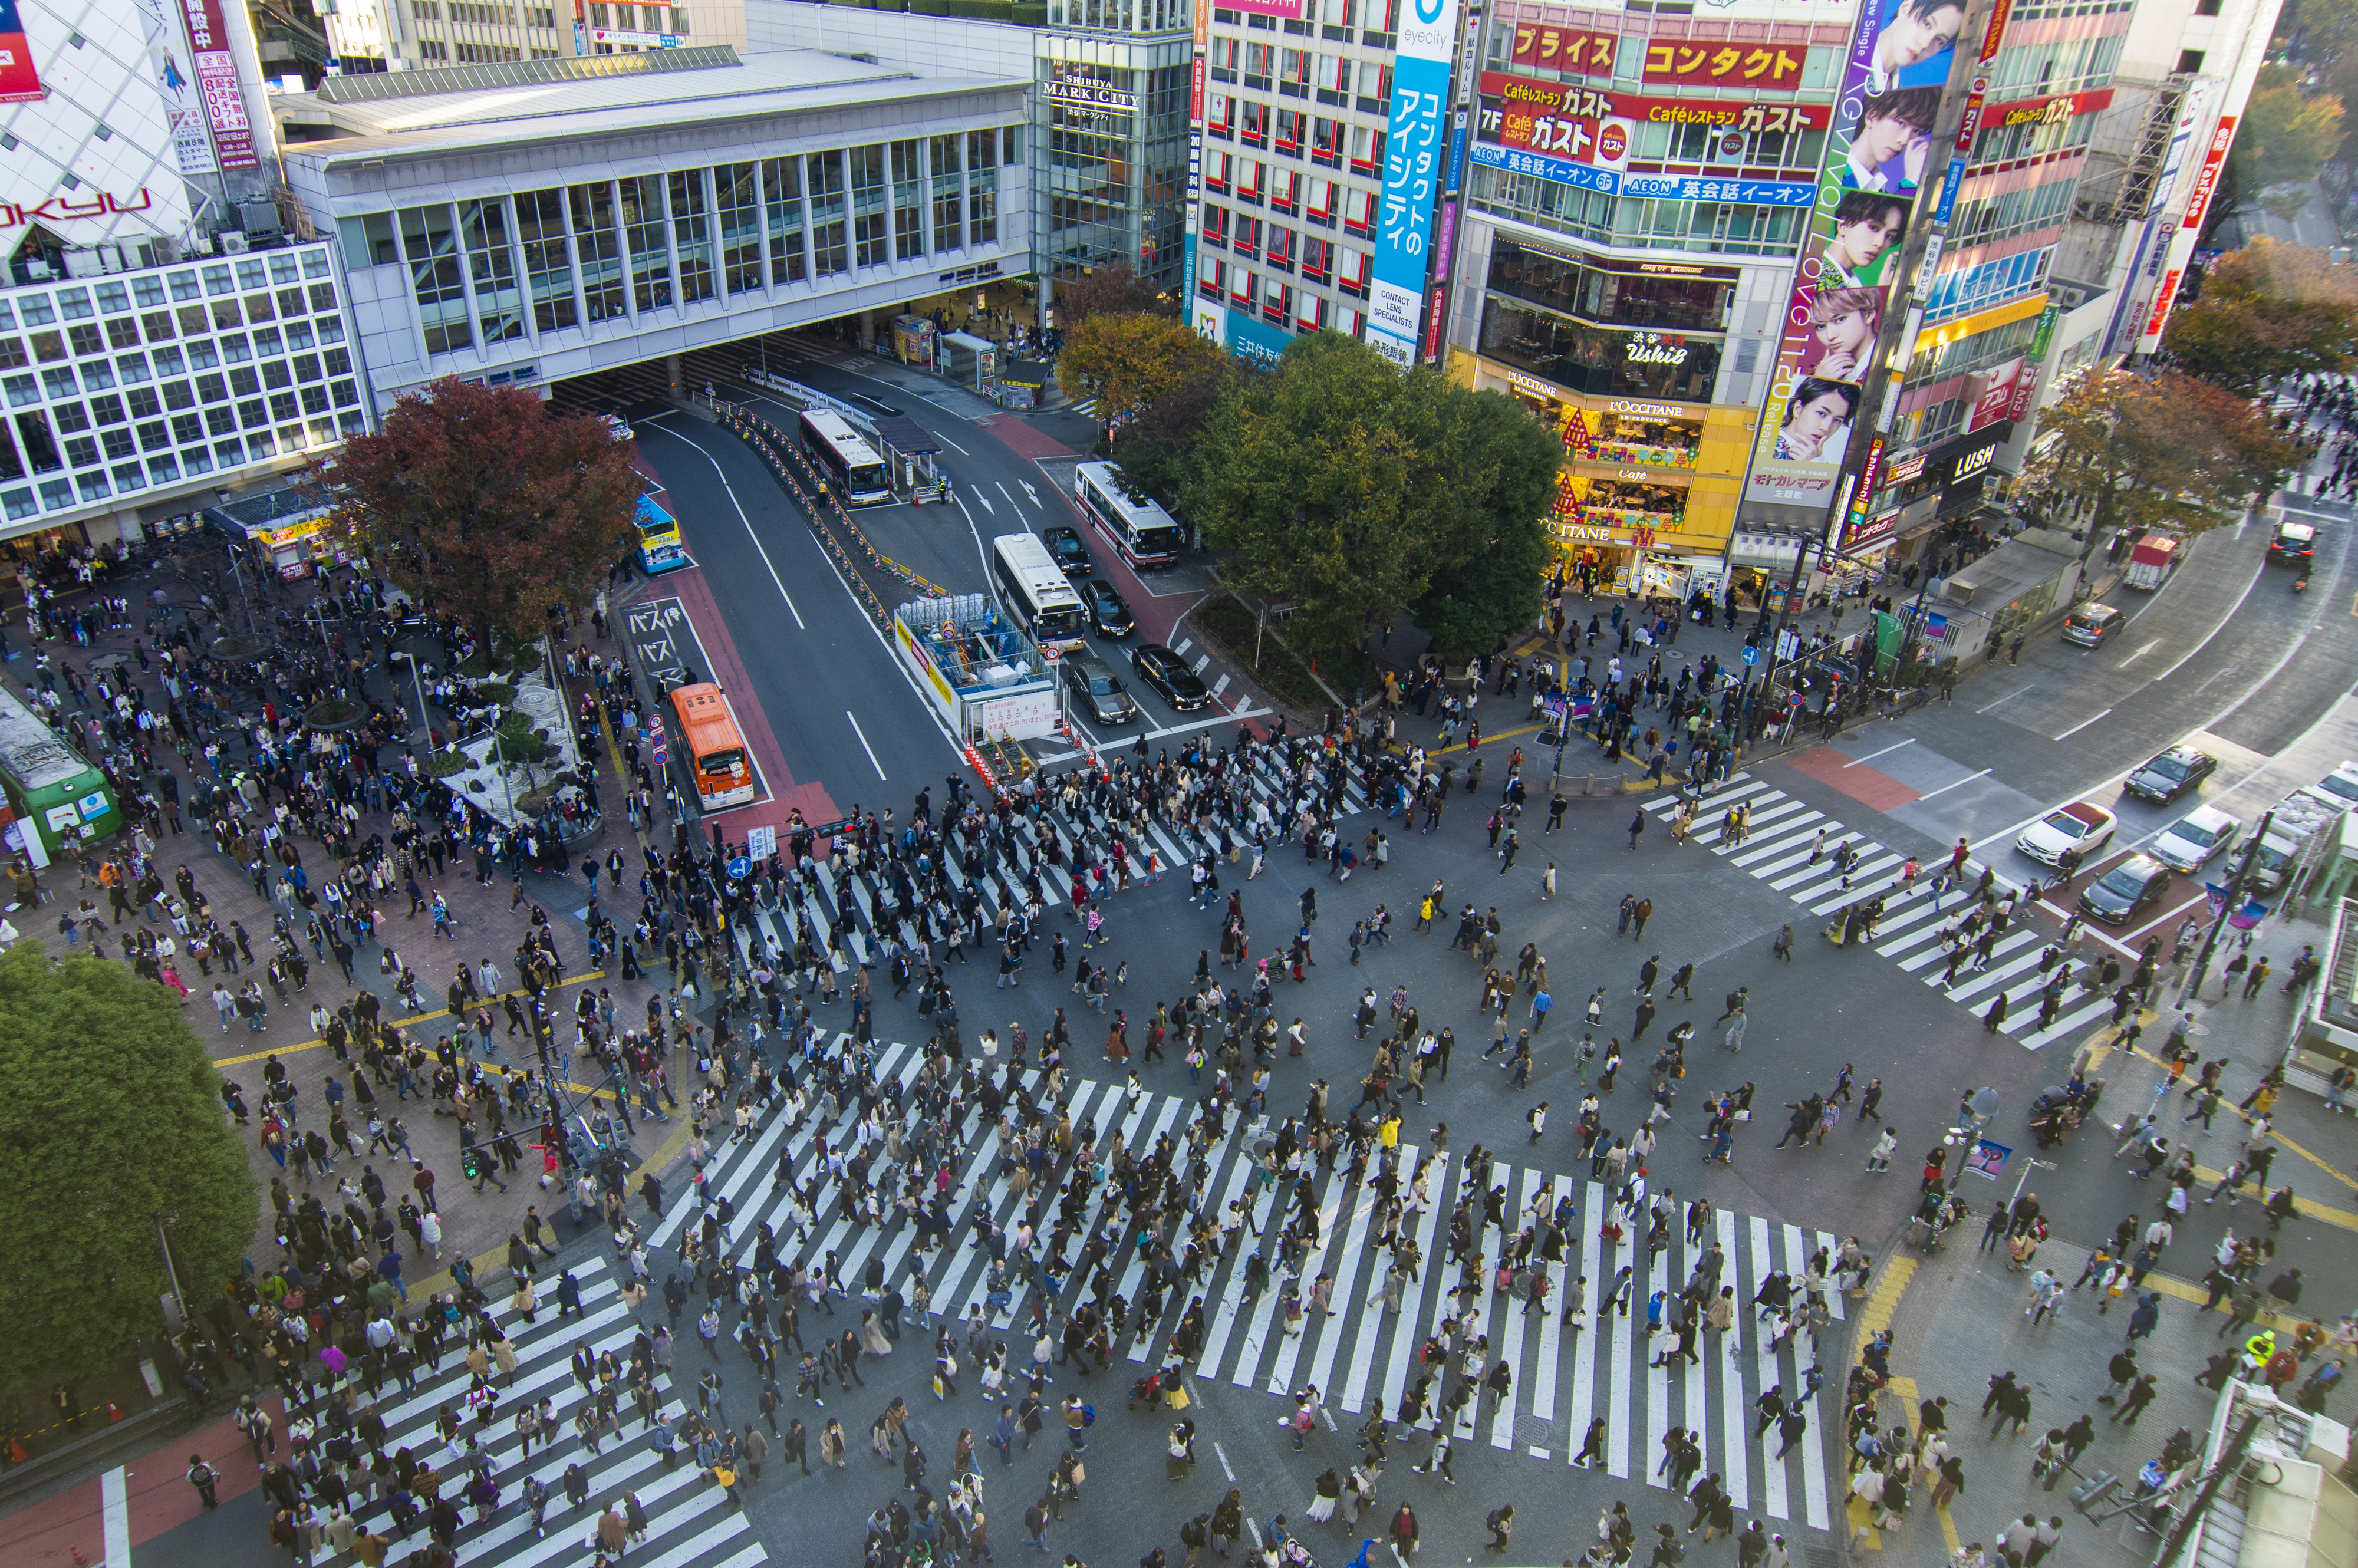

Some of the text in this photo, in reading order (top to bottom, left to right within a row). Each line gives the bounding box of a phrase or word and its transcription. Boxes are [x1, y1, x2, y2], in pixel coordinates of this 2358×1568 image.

[608, 33, 658, 41] ゆうメンタルクリニック
[1404, 29, 1447, 51] eyecity
[1516, 28, 1611, 67] プライス
[1858, 19, 1876, 56] Single
[202, 55, 229, 66] 全国
[1461, 38, 1475, 93] 献血ルーム
[1645, 46, 1799, 79] コンタクト
[1066, 74, 1112, 88] SHIBUYA
[1194, 58, 1203, 92] 外貨両替
[214, 78, 235, 128] 配送ギフト
[225, 77, 246, 127] 全国無料
[1043, 81, 1140, 106] MARK CITY
[1562, 88, 1612, 118] ガスト
[1481, 108, 1503, 130] 7F
[1507, 113, 1532, 131] Café
[1738, 104, 1812, 133] ガスト
[2041, 97, 2075, 124] ガスト
[1505, 129, 1530, 142] レストラン
[1531, 114, 1592, 156] ガスト
[1961, 108, 1978, 143] ガスト
[1451, 130, 1461, 188] コンタクトのアイシティ
[1602, 139, 1624, 152] ガスト
[1723, 141, 1741, 150] ガスト
[1188, 134, 1200, 187] 加藤眼科
[1385, 88, 1420, 249] アイシティ
[1474, 148, 1612, 189] AEON 英会話イーオン 6F
[1405, 93, 1439, 256] コンタクトの
[1630, 179, 1812, 203] AEON 英会話イーオン
[1939, 165, 1961, 220] 英会話イーオン
[1438, 216, 1451, 269] 品川美容外科
[1184, 251, 1193, 309] 三井住友信託銀行
[1791, 232, 1846, 326] Love
[1918, 241, 1939, 295] 渋谷駅前ビル
[1381, 289, 1410, 307] CONTACT
[1386, 301, 1402, 314] LENS
[1431, 289, 1443, 327] 外貨両替
[1374, 307, 1413, 329] SPECIALISTS
[1632, 331, 1658, 344] 渋谷
[1626, 342, 1688, 365] Ushi8
[1771, 334, 1810, 399] 11.20
[1507, 370, 1557, 397] L'OCCITANE
[1609, 400, 1684, 417] L'OCCITANE
[1981, 386, 2008, 411] アコム
[2013, 389, 2026, 411] アコム
[1758, 402, 1781, 453] Release
[1984, 410, 1996, 424] 3F
[1954, 443, 1997, 477] LUSH
[1618, 469, 1648, 481] Café
[1753, 473, 1831, 491] モトカレマニア
[1859, 456, 1879, 499] サンドラッグ
[1774, 489, 1803, 500] 主題歌
[984, 700, 1017, 710] 今週の通行止め実施日
[987, 715, 1043, 731] 今夜通行止め 行いません
[755, 831, 764, 858] 渋谷駅前
